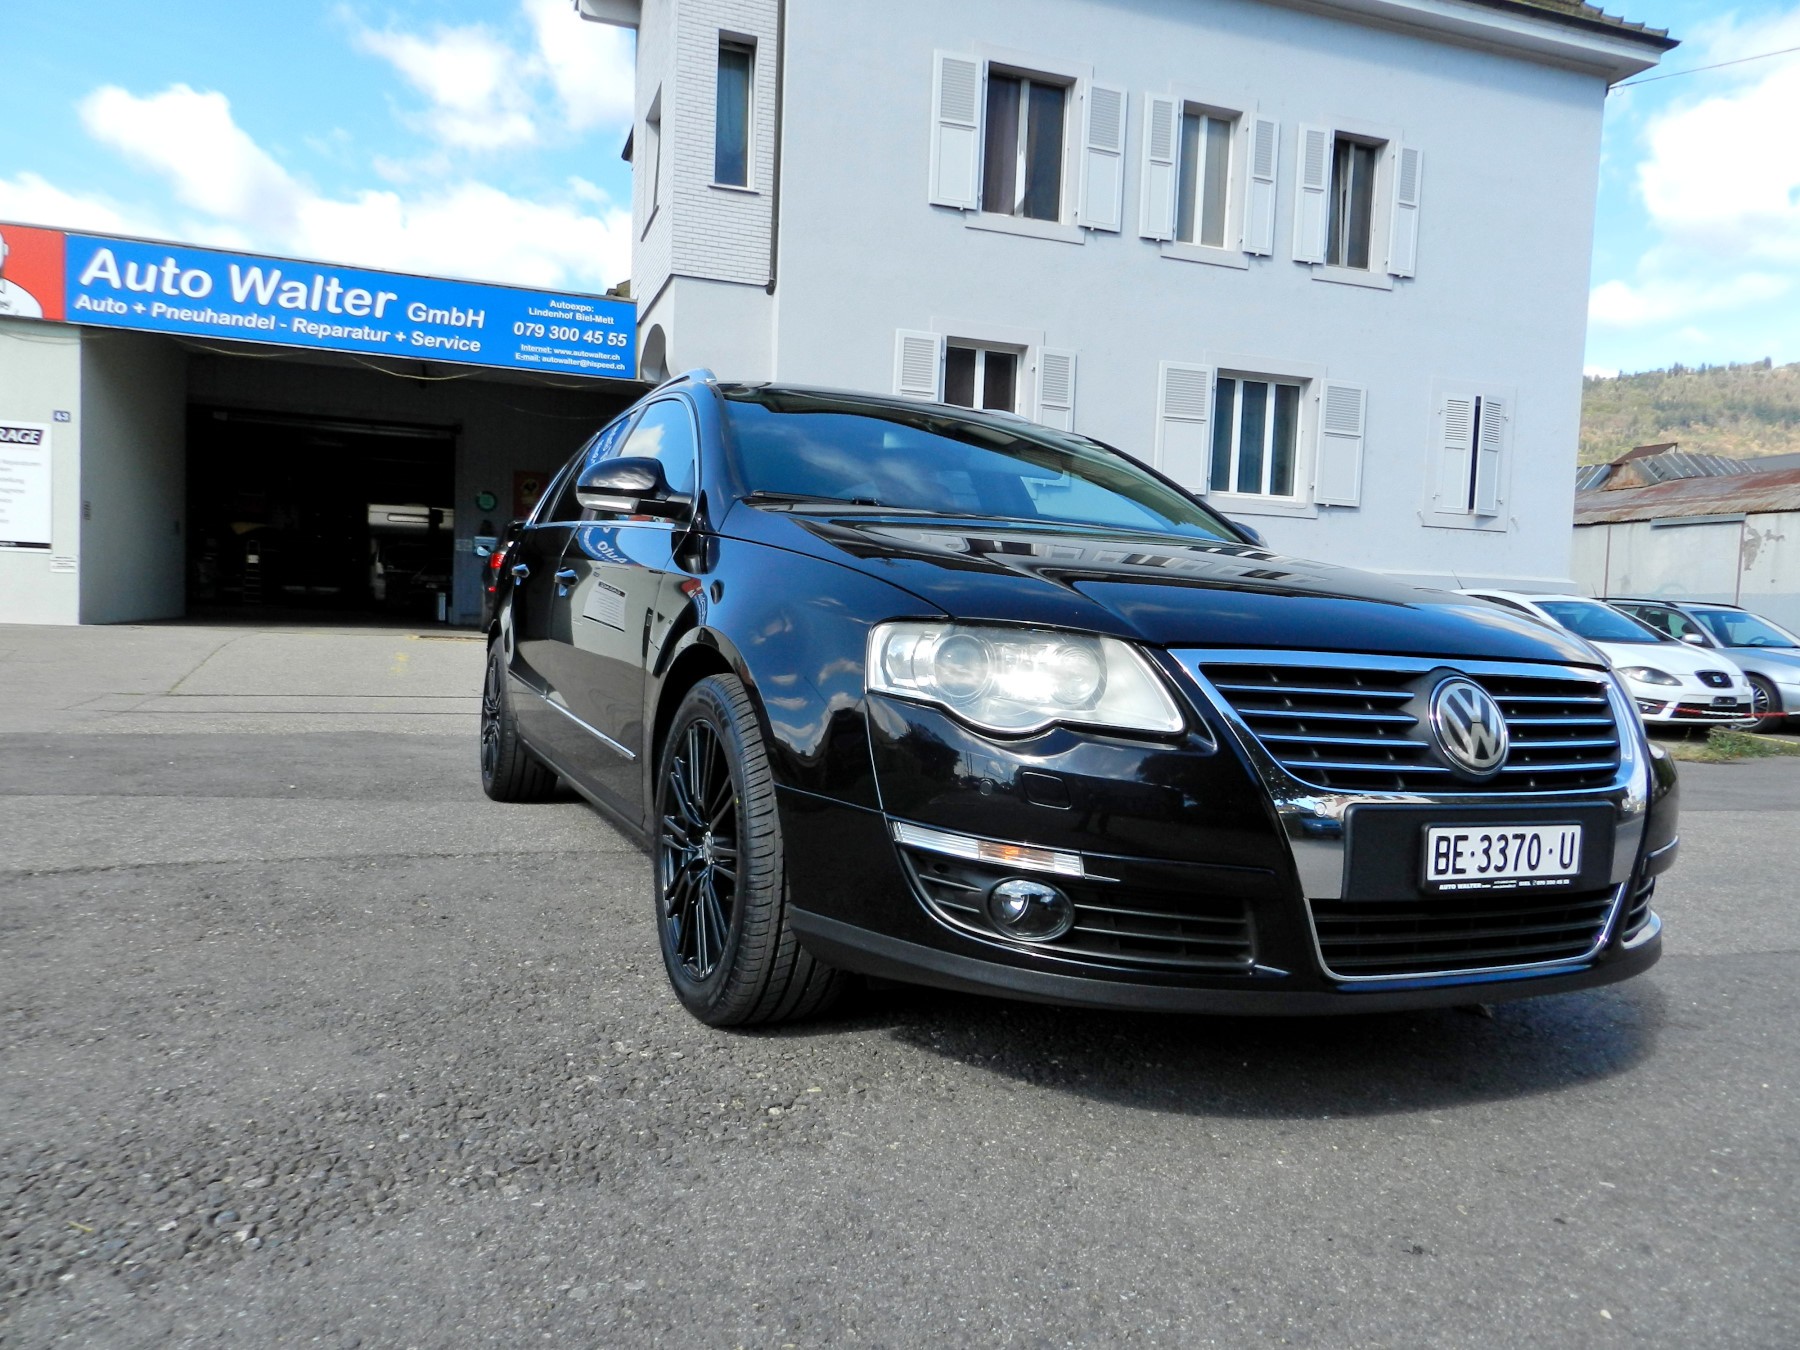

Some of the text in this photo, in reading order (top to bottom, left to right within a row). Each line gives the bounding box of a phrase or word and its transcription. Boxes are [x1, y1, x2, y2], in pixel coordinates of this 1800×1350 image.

[80, 248, 485, 329] Auto Walter GmbH
[528, 307, 615, 325] Lindenhof Biel-Mett
[549, 300, 595, 313] Autoexpo:
[75, 294, 128, 314] Auto
[152, 302, 276, 330] Pneuhandel
[292, 317, 391, 342] Reparatur
[411, 330, 481, 352] Service
[514, 322, 627, 347] 079 300 45 55
[515, 352, 625, 371] E-mail: autowalter@hispeed.ch
[521, 343, 620, 361] Internet: www.autowalter.ch
